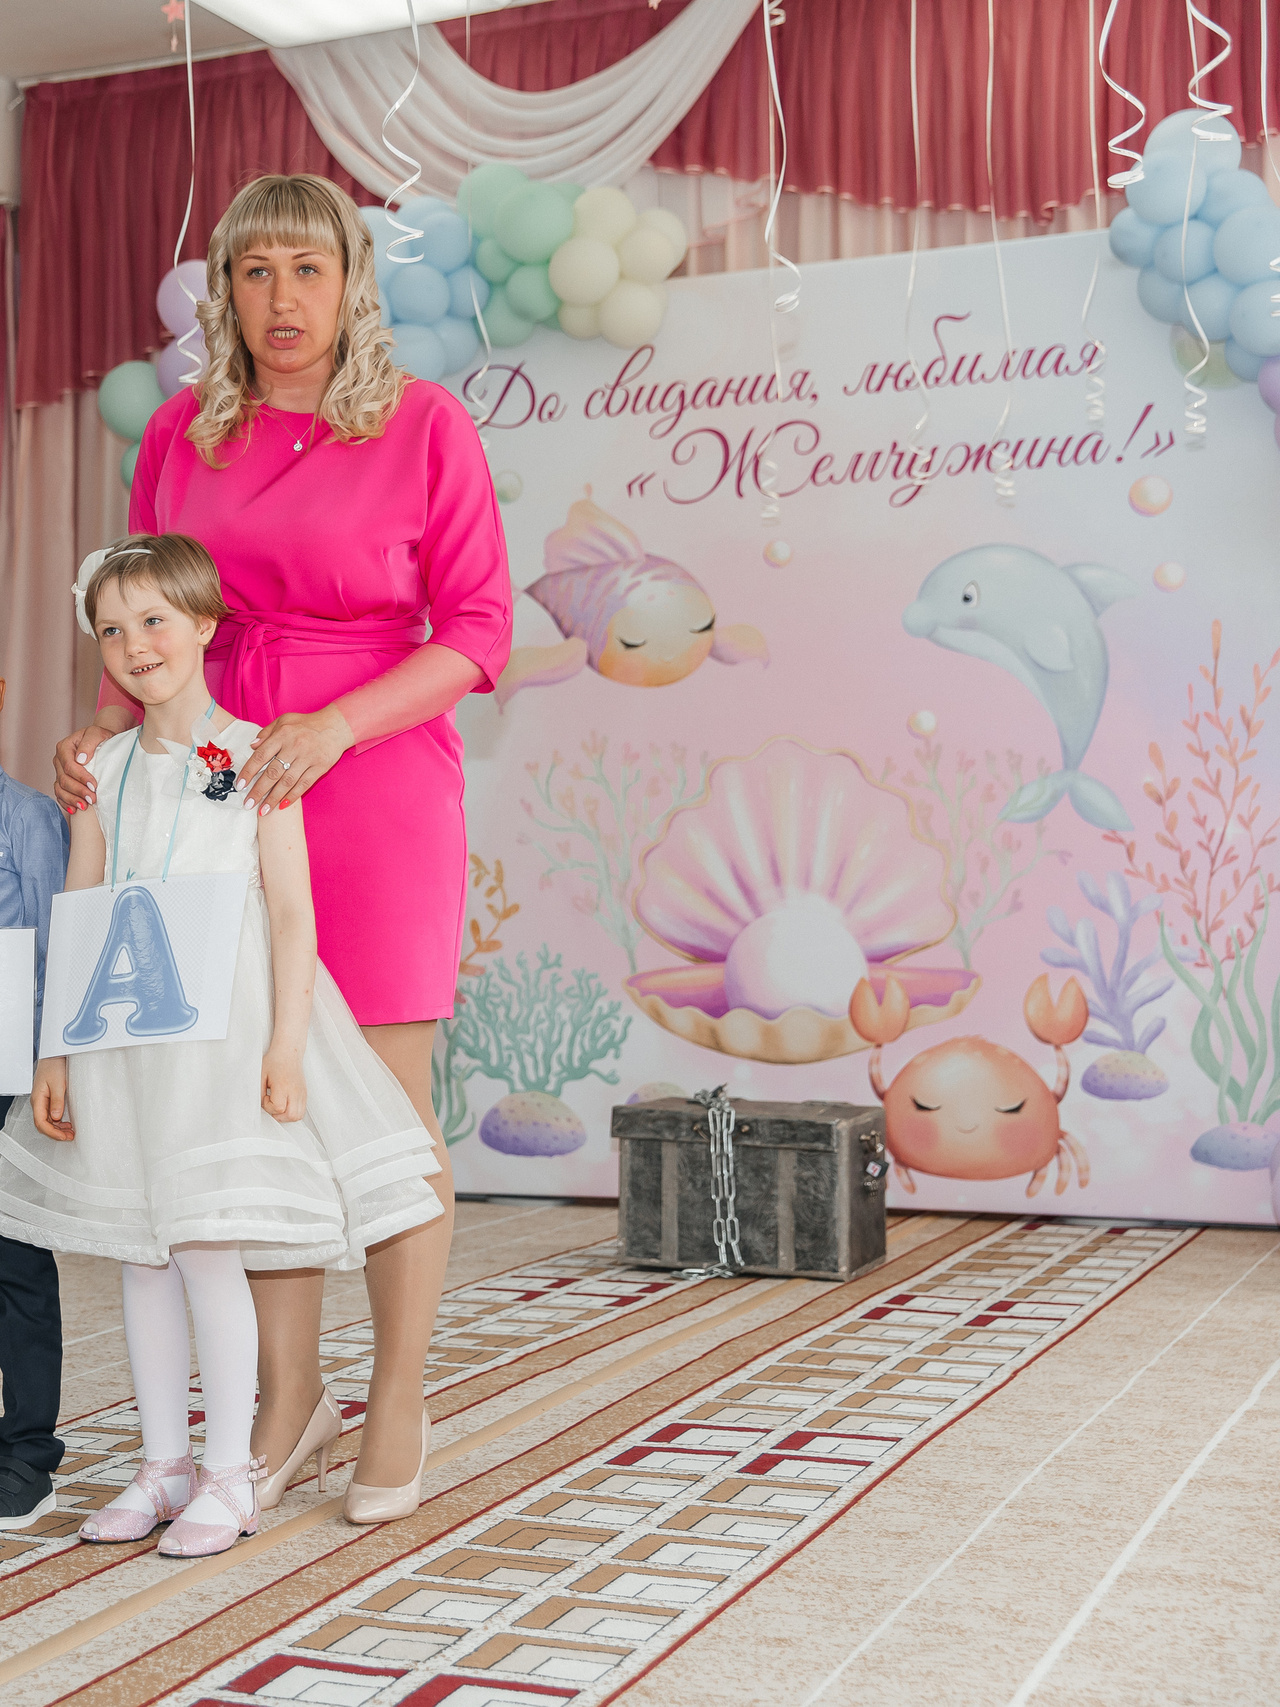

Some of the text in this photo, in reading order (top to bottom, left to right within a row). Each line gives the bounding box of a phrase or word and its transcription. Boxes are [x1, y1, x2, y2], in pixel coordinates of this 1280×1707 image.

[461, 311, 1105, 438] До свидания, любимая
[62, 886, 199, 1046] А
